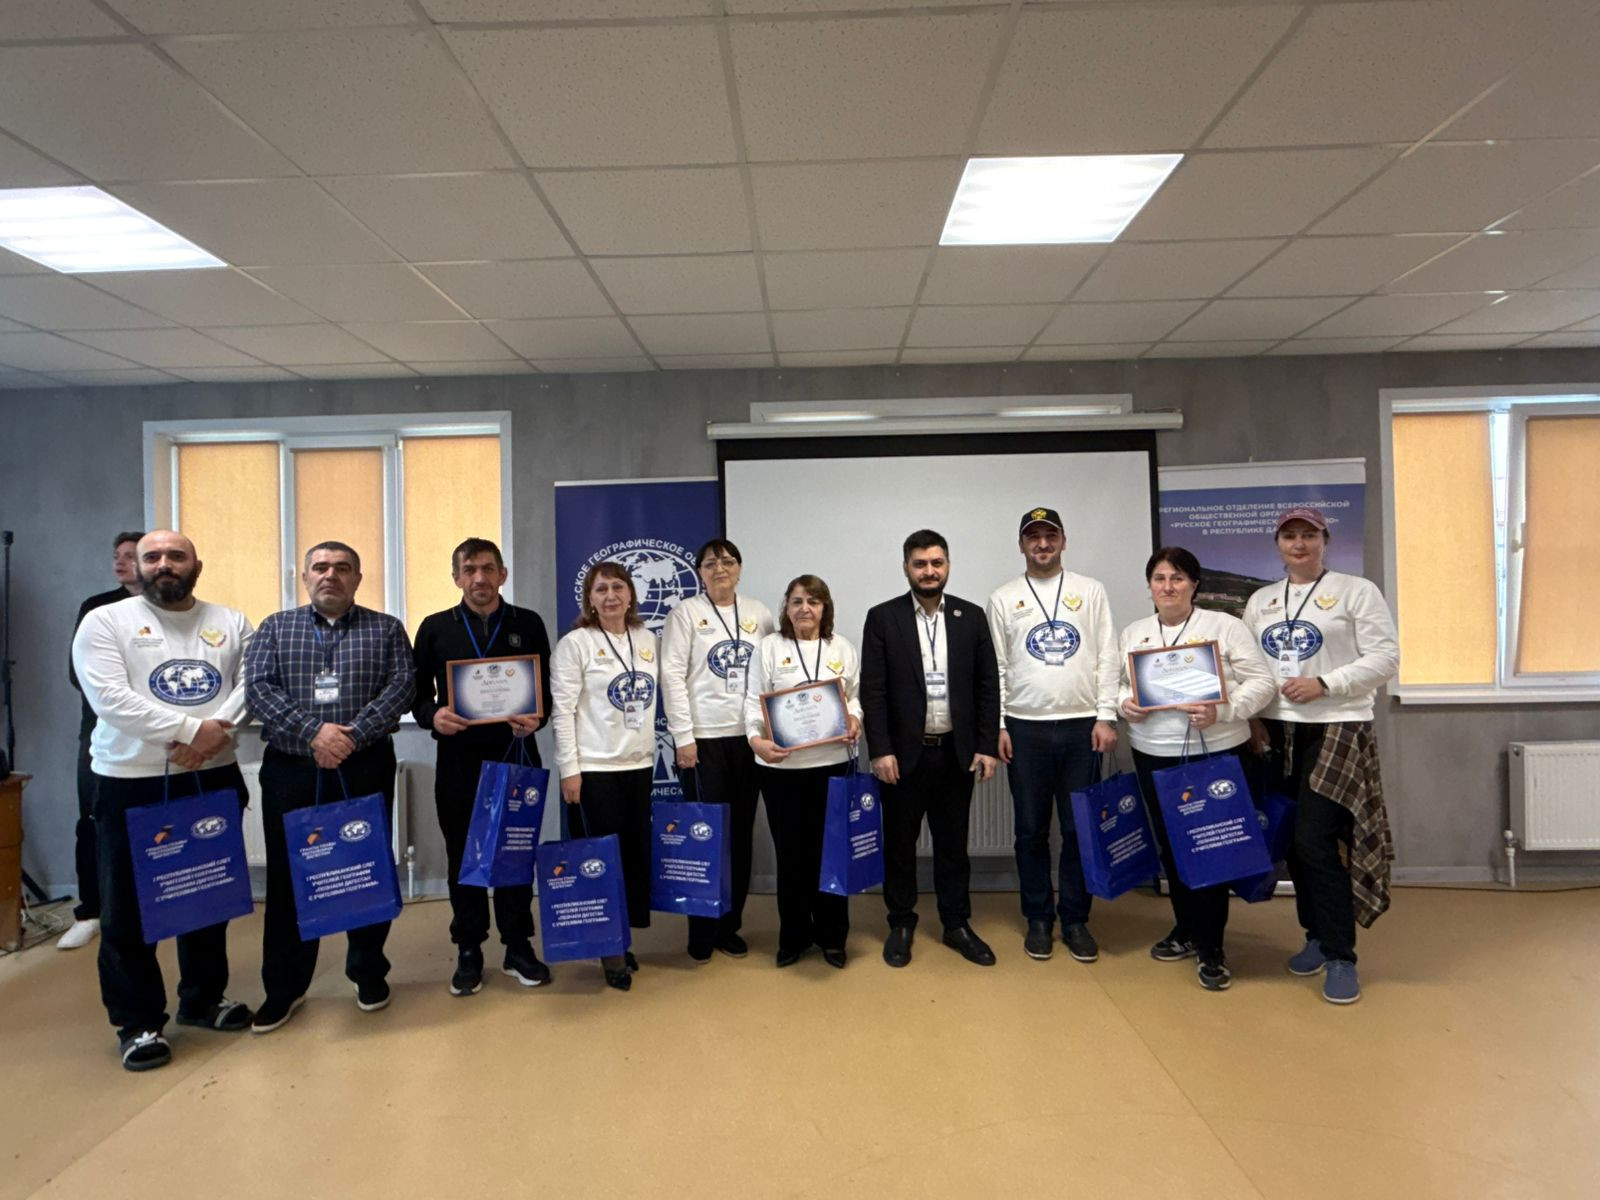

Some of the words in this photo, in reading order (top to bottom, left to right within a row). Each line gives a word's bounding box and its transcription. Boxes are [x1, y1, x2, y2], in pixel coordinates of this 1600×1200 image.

[1277, 500, 1350, 508] ВСЕРОССИЙСКОЙ
[1188, 510, 1258, 520] ОБЩЕСТВЕННОЙ
[1213, 518, 1278, 526] ГЕОГРАФИЧЕСК
[588, 539, 685, 566] ГЕОГРАФИЧЕСКОЕ
